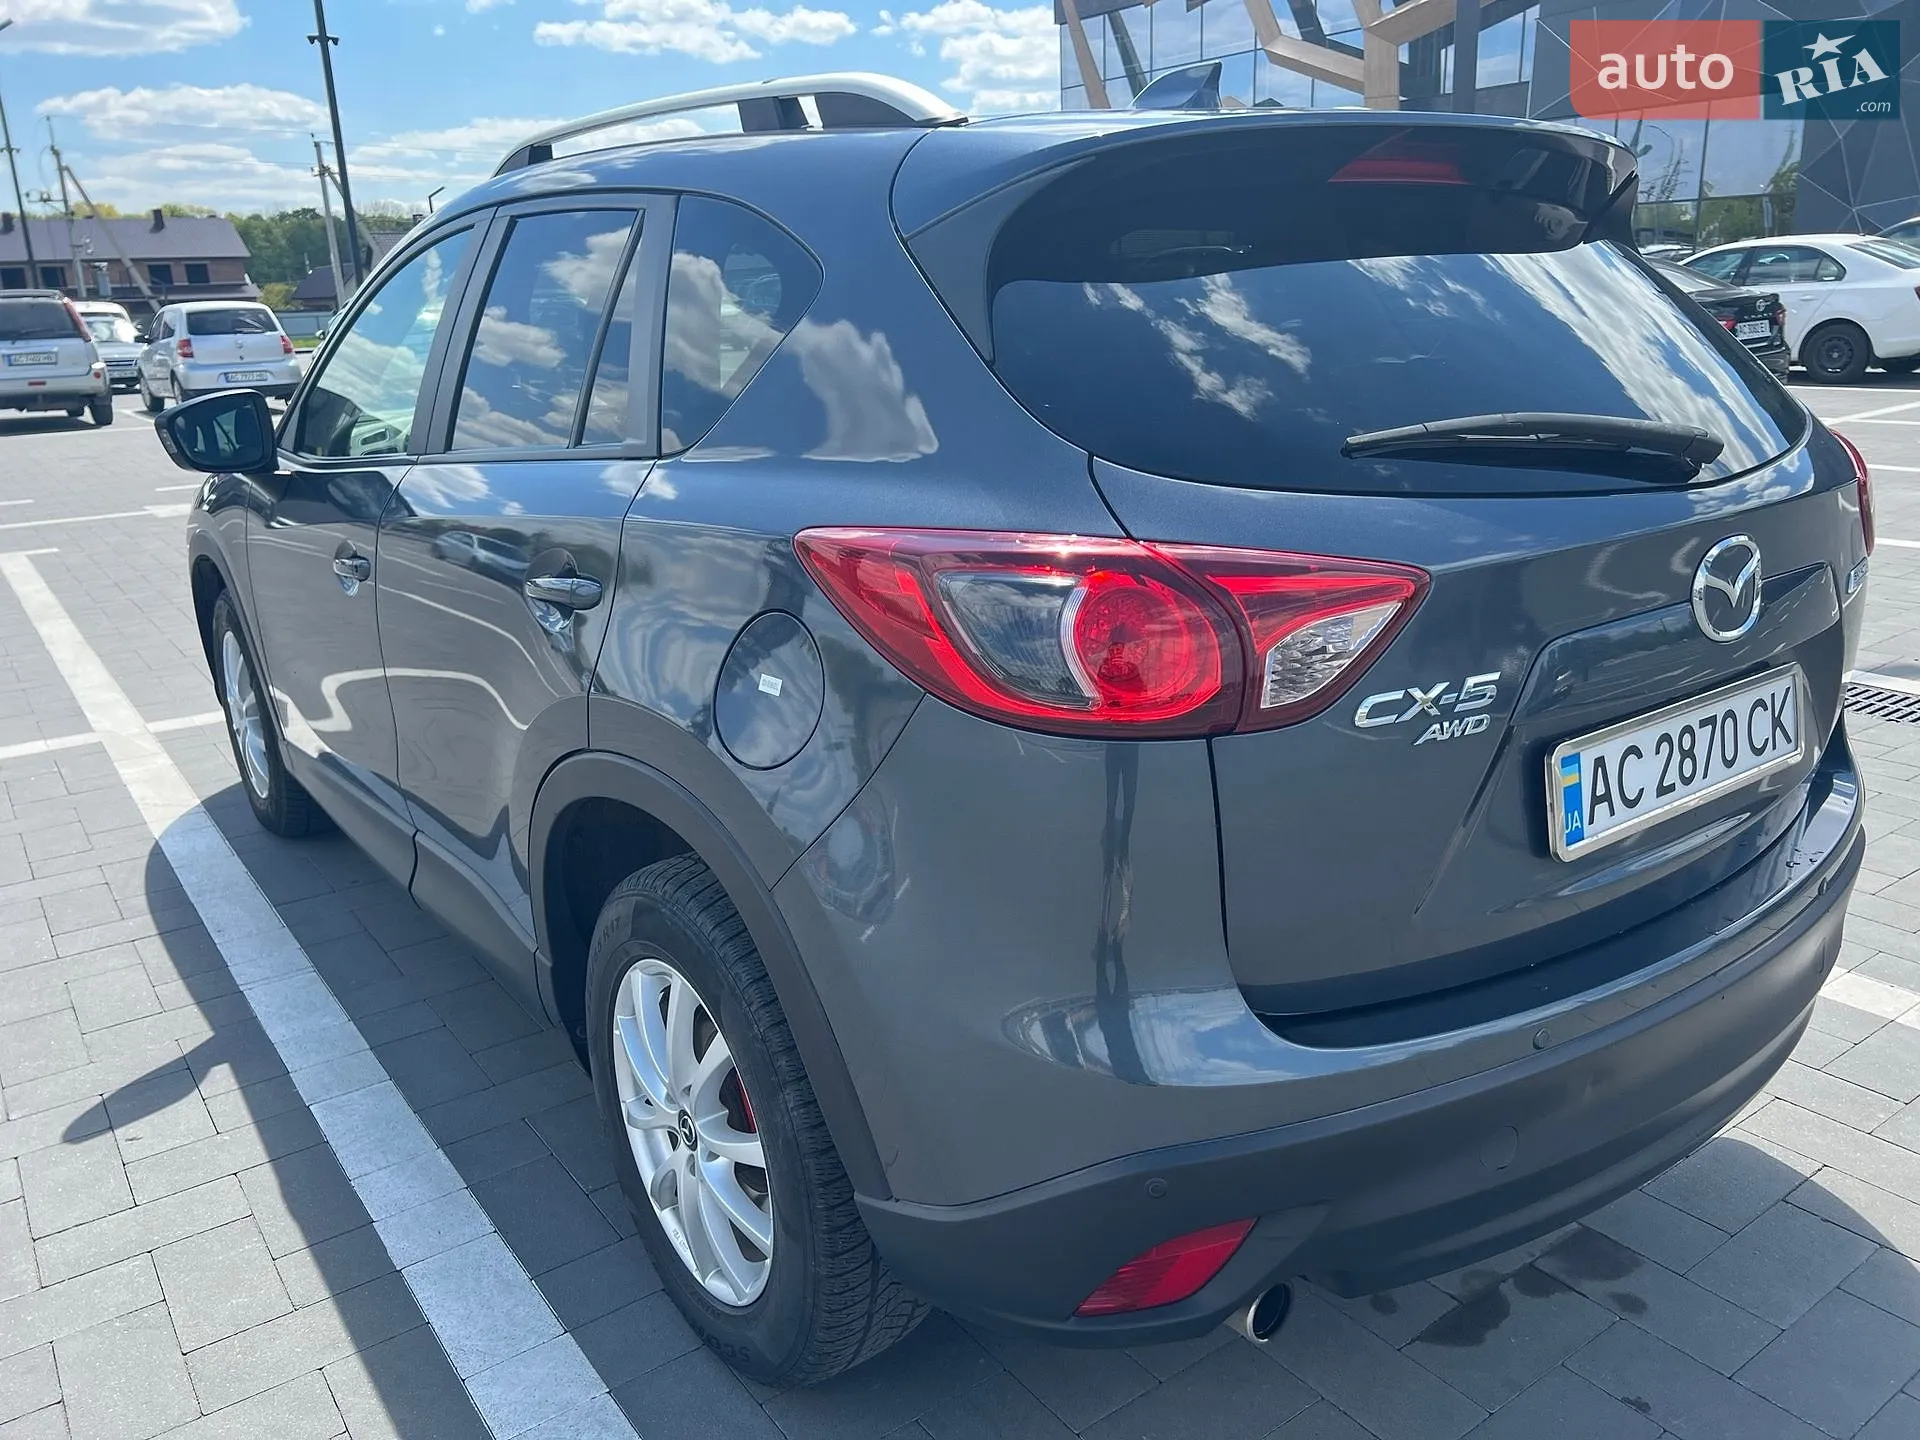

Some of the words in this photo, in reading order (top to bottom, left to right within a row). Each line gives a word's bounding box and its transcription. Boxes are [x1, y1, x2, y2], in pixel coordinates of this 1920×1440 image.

[1354, 671, 1501, 728] CX-5
[1413, 713, 1491, 746] AWD
[1588, 745, 1645, 826] AC
[1655, 709, 1739, 799] 2870
[1747, 686, 1793, 757] CK
